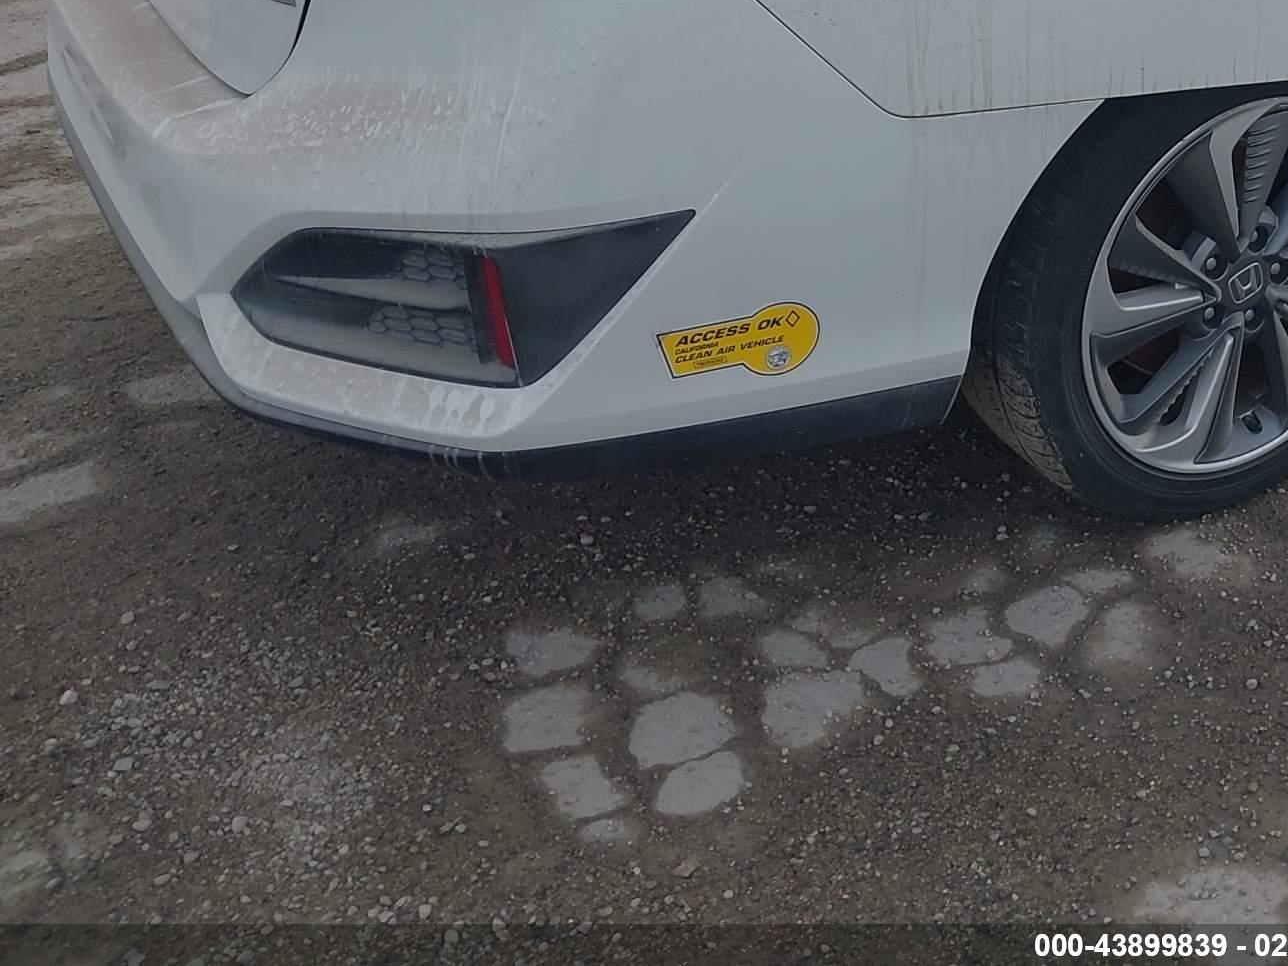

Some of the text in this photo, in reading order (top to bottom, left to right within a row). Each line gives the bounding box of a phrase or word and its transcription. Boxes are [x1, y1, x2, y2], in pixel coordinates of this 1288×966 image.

[675, 315, 785, 347] ACCESS OK
[674, 341, 719, 355] CALIFORNIA
[674, 349, 713, 364] CLEAN
[716, 345, 736, 356] AIR
[740, 335, 785, 351] VEHICLE
